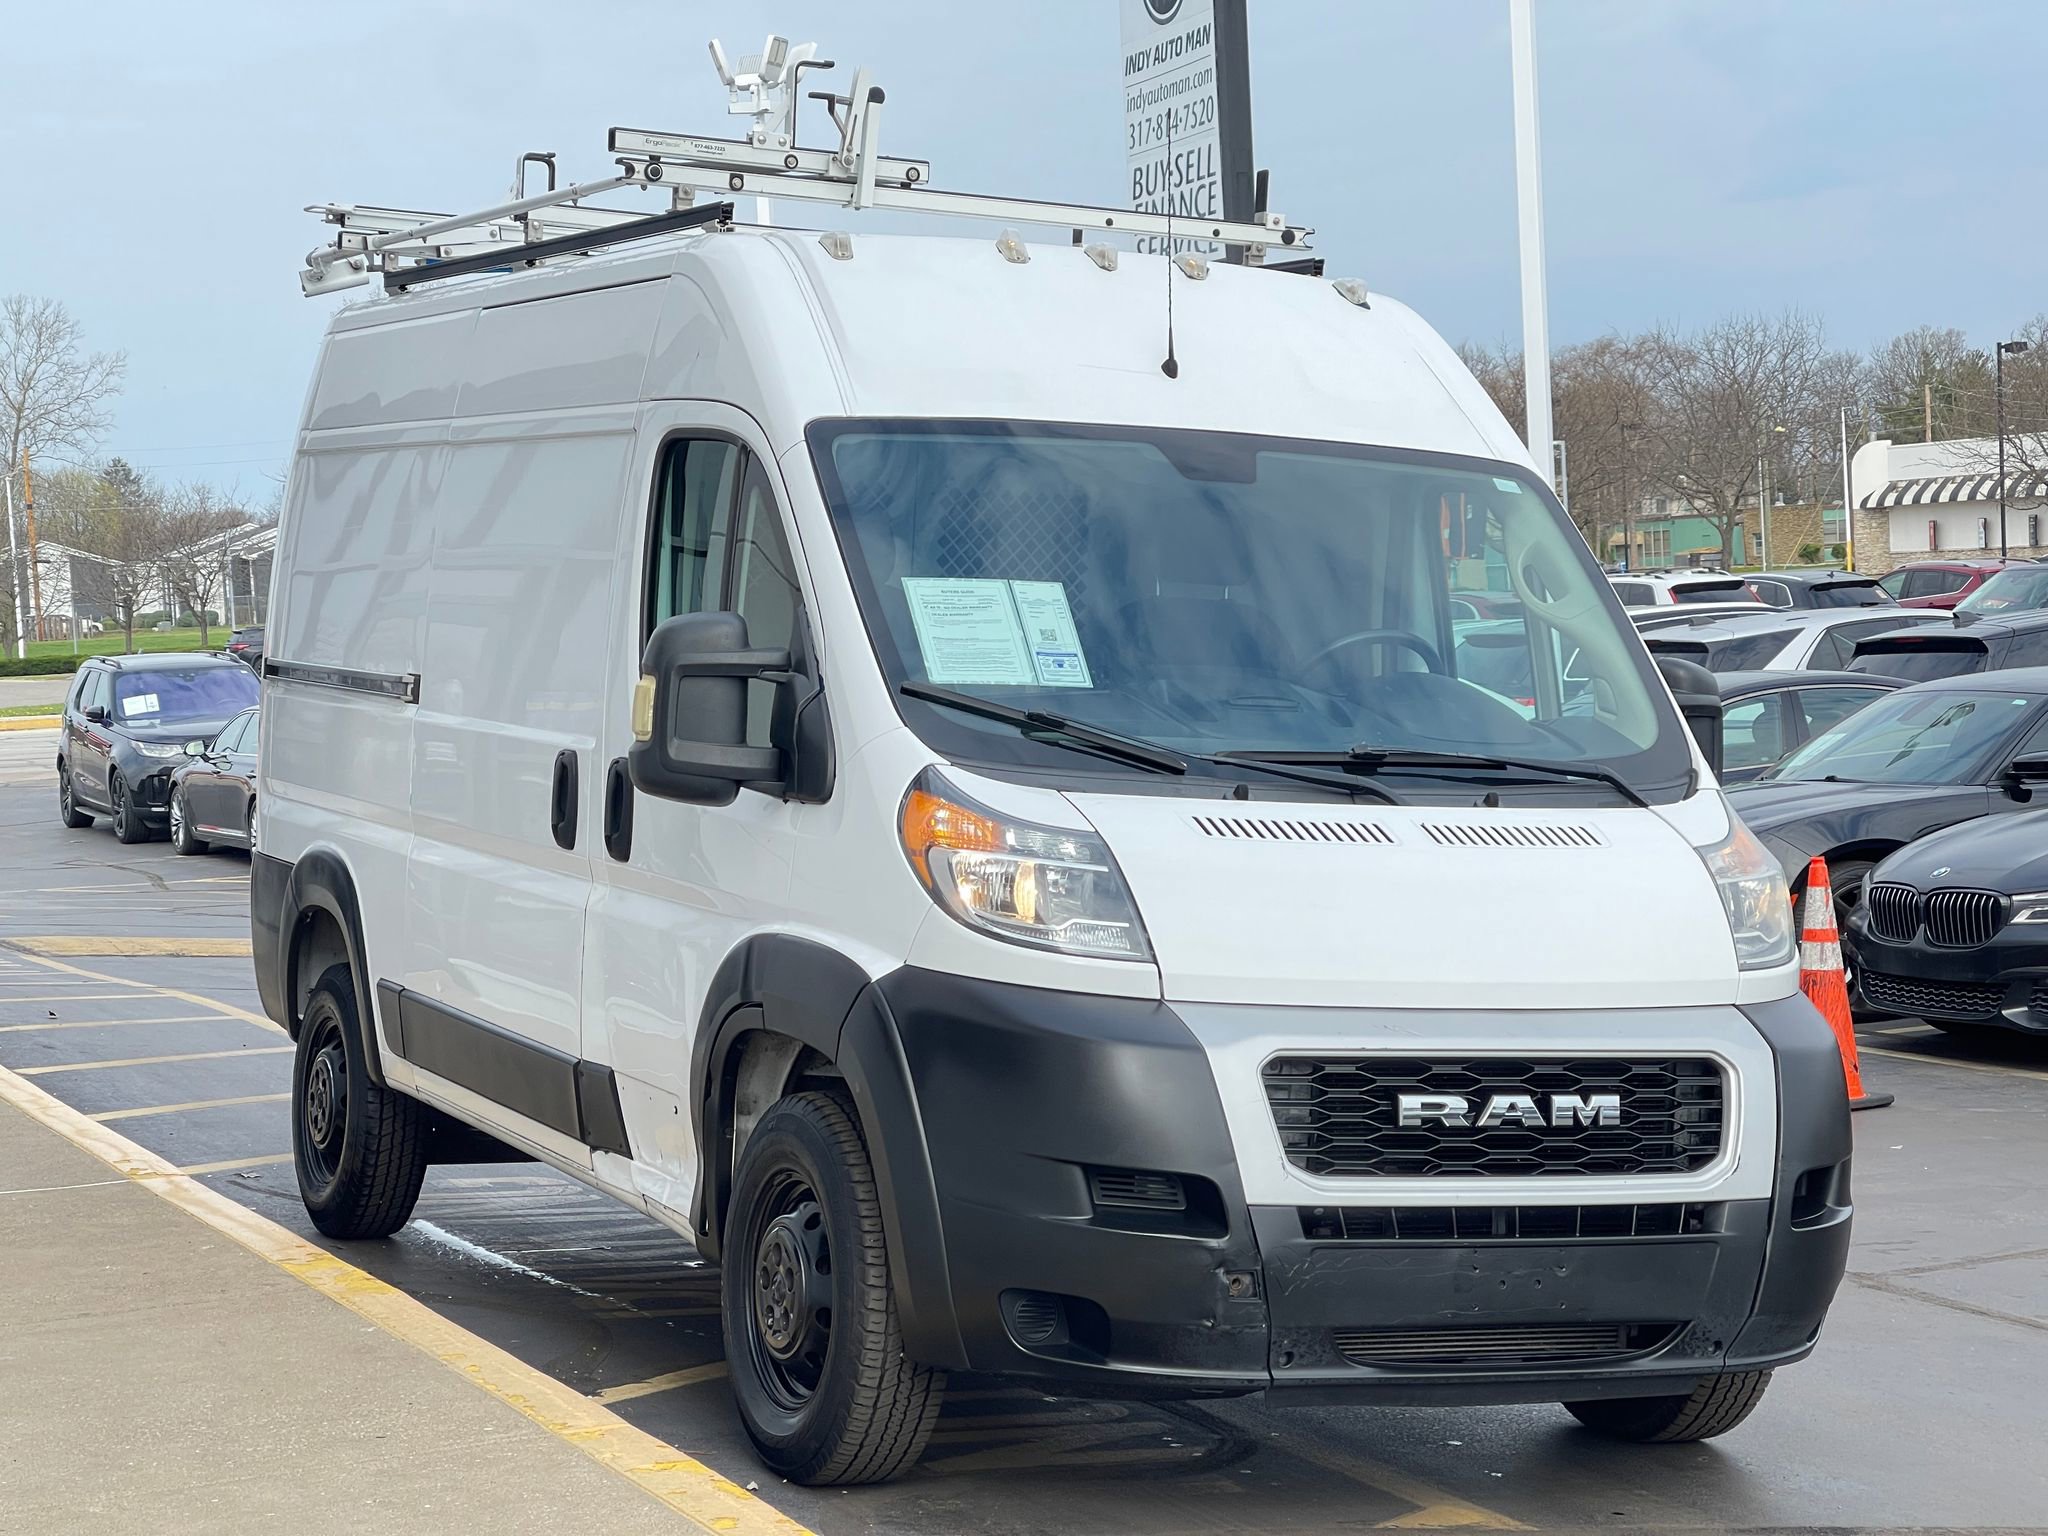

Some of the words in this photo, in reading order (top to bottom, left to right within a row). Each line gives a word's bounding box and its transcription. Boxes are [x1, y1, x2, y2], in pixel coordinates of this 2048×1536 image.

[1125, 48, 1151, 77] INDY
[1153, 35, 1183, 66] AUTO
[1185, 23, 1211, 54] MAN
[1126, 67, 1213, 115] indyautoman.com
[1135, 180, 1217, 218] ANCE
[1398, 1094, 1621, 1127] RAM
